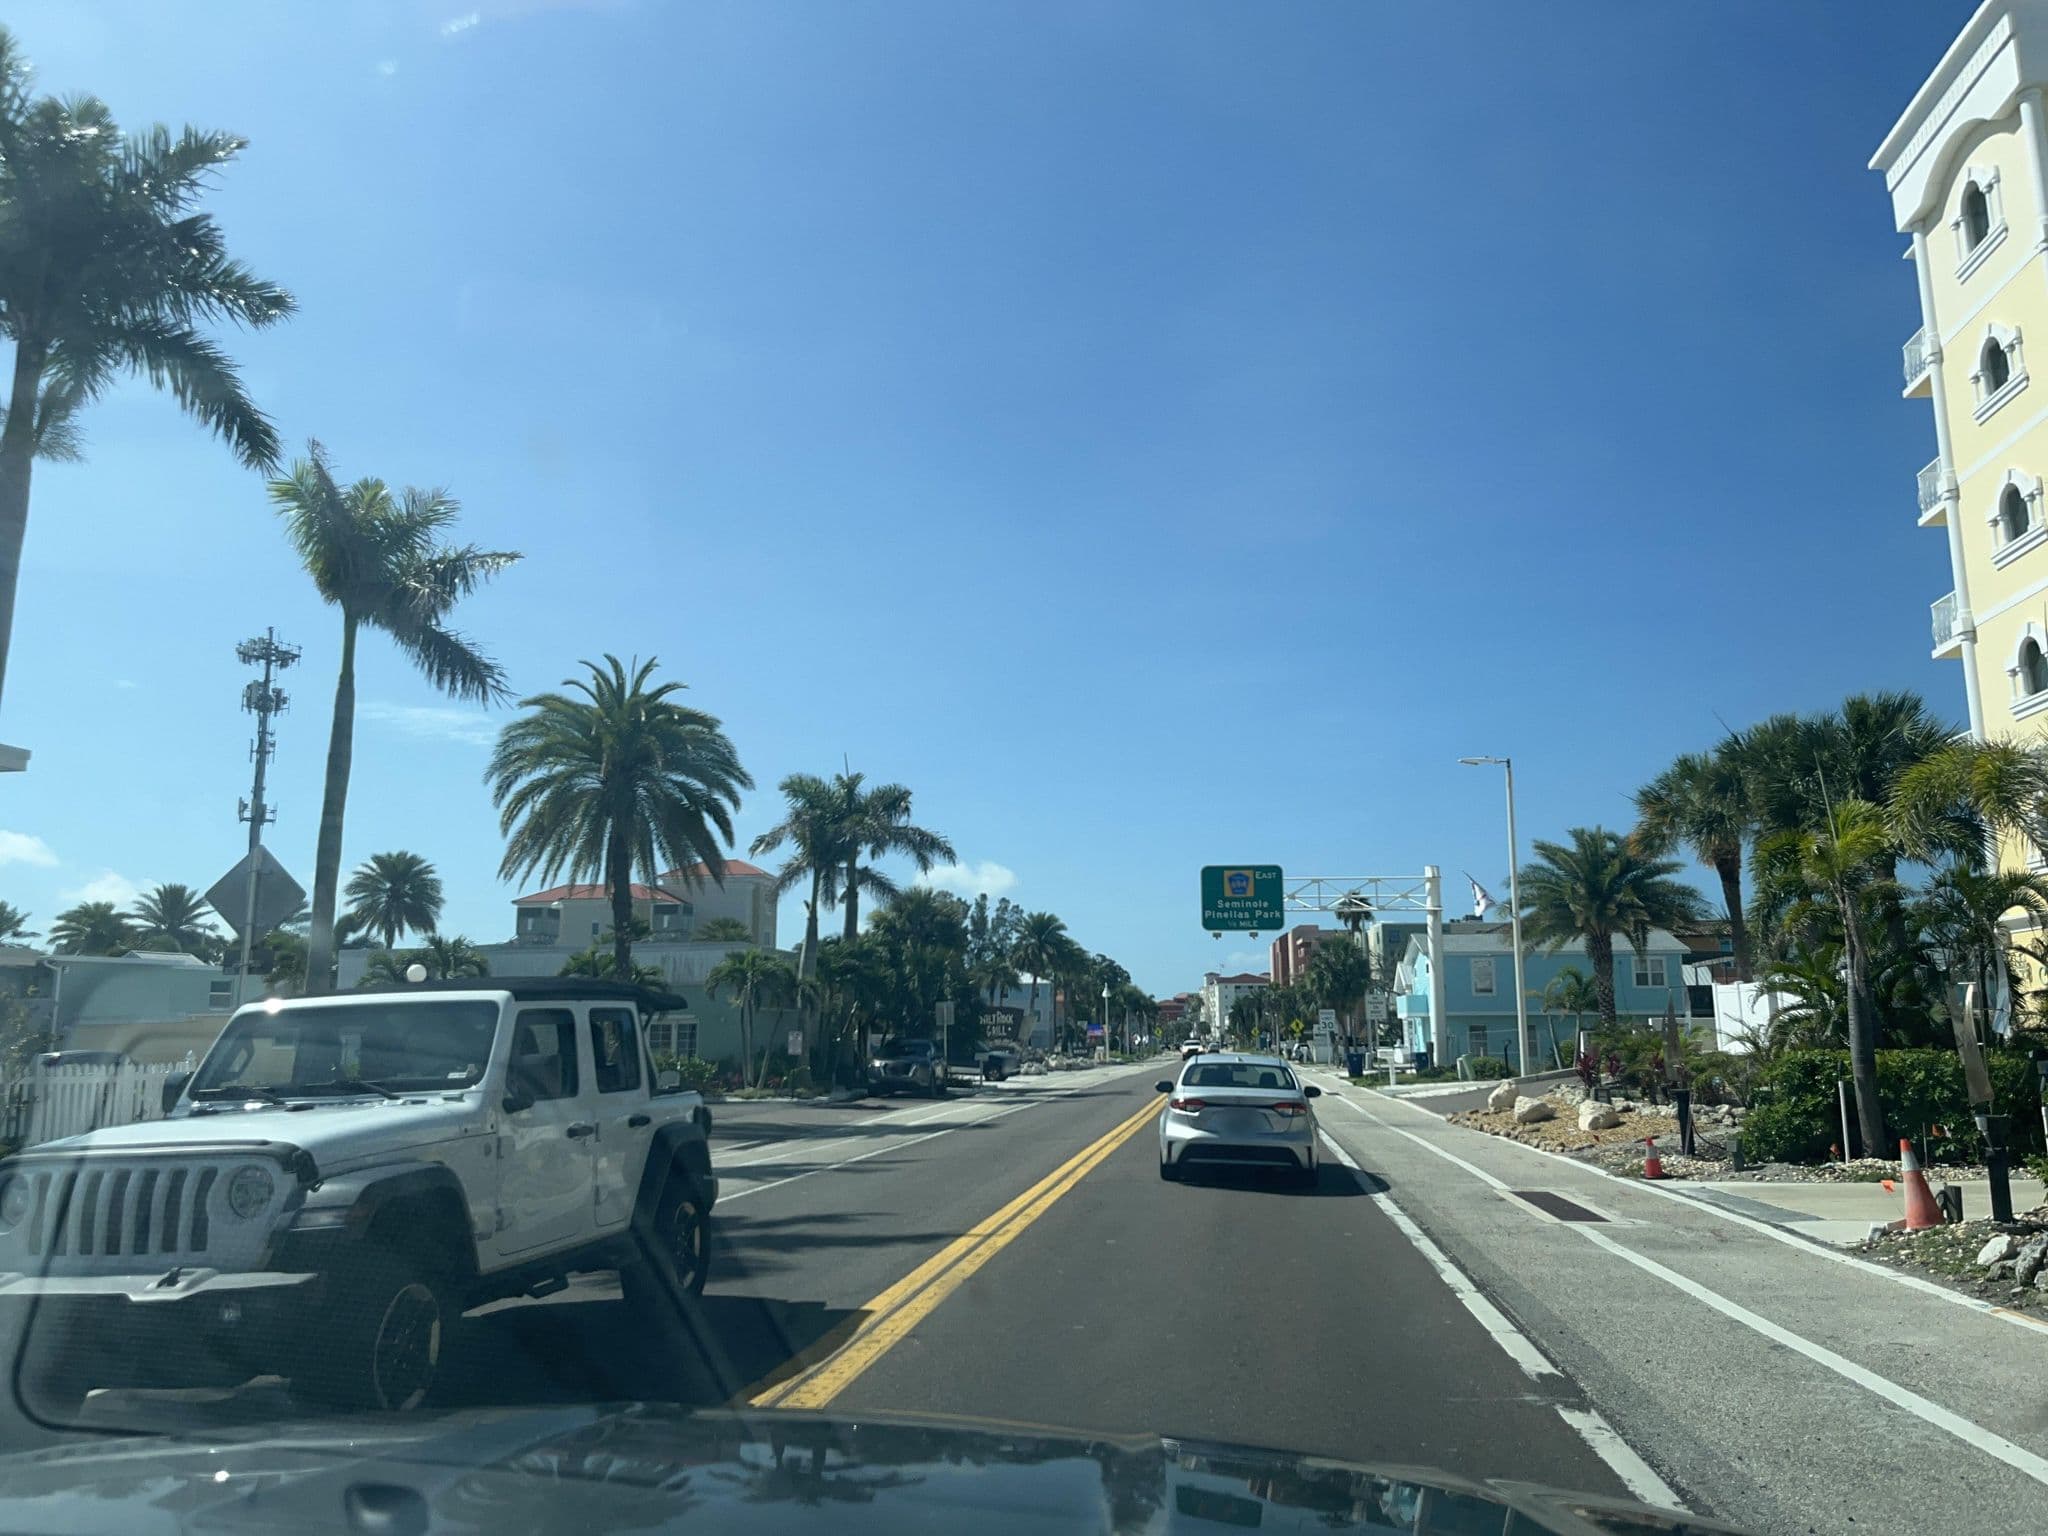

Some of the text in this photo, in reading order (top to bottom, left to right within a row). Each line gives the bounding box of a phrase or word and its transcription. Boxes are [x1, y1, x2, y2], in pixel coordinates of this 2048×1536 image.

[1255, 871, 1277, 879] EAST
[1217, 899, 1269, 908] Seminole
[1205, 910, 1281, 919] Pinellas Park
[1321, 1021, 1334, 1029] 30
